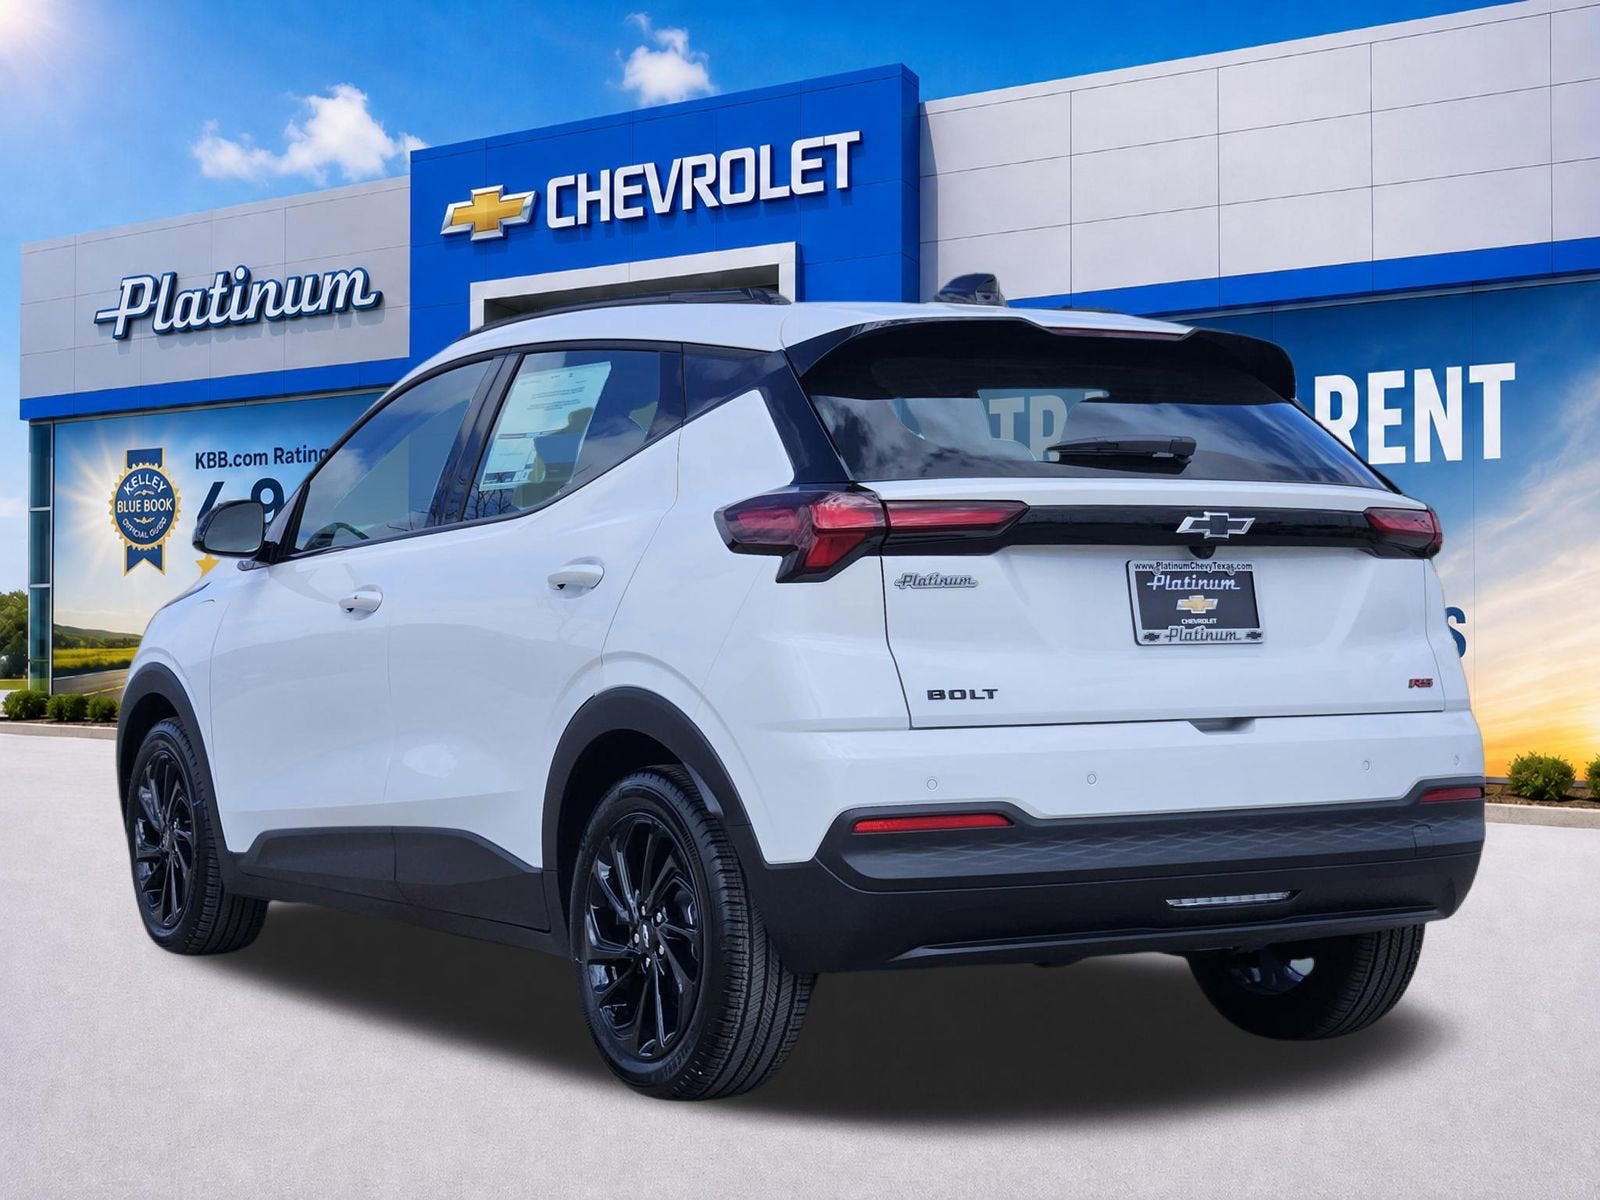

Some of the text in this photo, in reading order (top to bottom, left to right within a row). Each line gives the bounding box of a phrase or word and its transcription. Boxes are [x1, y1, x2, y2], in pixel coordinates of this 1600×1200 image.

[547, 130, 861, 229] CHEVROLET
[94, 265, 384, 339] Platinum
[195, 451, 268, 470] KBB.com
[123, 473, 167, 495] KELLEY
[117, 498, 173, 513] BLUE BOOK
[1135, 561, 1253, 573] www.PlatinumChevyTexas.com
[894, 572, 979, 590] Platinum
[1146, 574, 1241, 591] Platinum
[1164, 626, 1241, 642] Platinum
[1408, 678, 1434, 689] RS
[926, 688, 999, 701] BOLT
